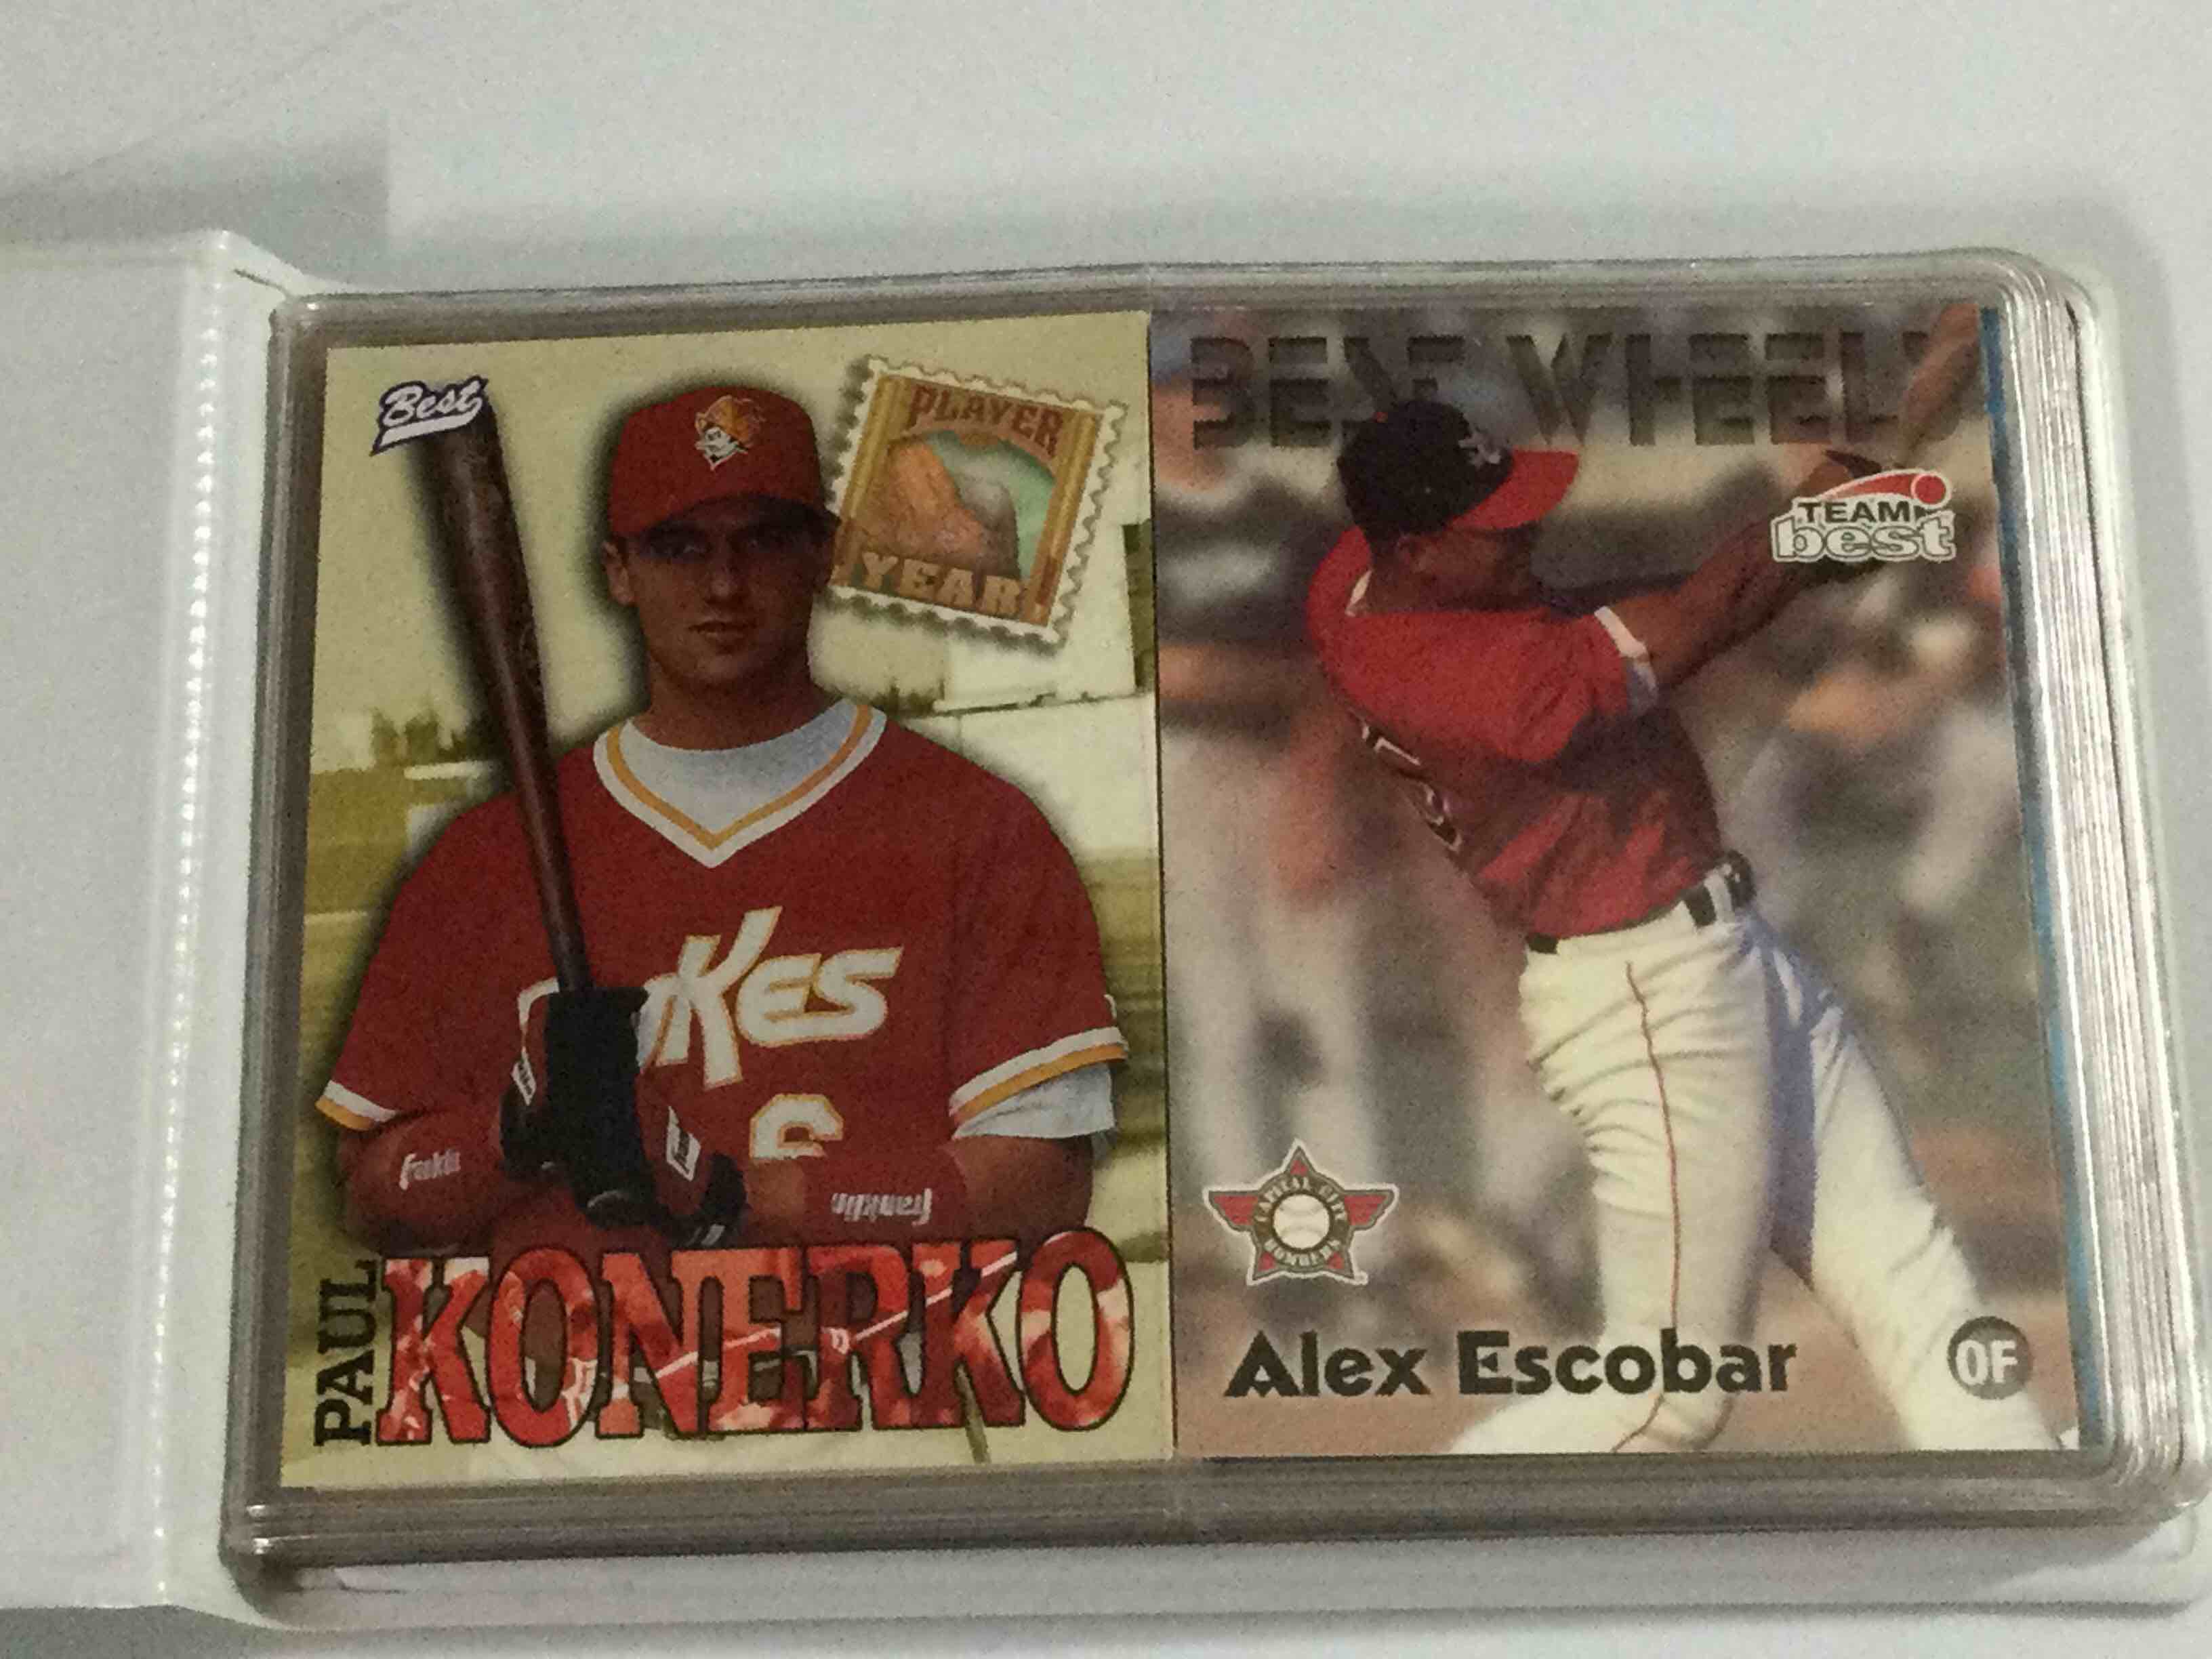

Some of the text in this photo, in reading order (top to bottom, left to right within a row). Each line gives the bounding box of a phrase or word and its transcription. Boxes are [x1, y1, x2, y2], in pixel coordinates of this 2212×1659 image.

[377, 375, 487, 437] Best
[909, 384, 1064, 459] PLAYER
[1506, 331, 1931, 447] WHEEL
[1772, 513, 1956, 562] best
[1797, 500, 1910, 523] TEAM
[861, 551, 1022, 617] YEAR
[312, 1259, 377, 1447] PAUL
[375, 1227, 1136, 1448] KONERKO
[1223, 1327, 1798, 1398] Alex Escobar
[1955, 1338, 2019, 1387] OF
